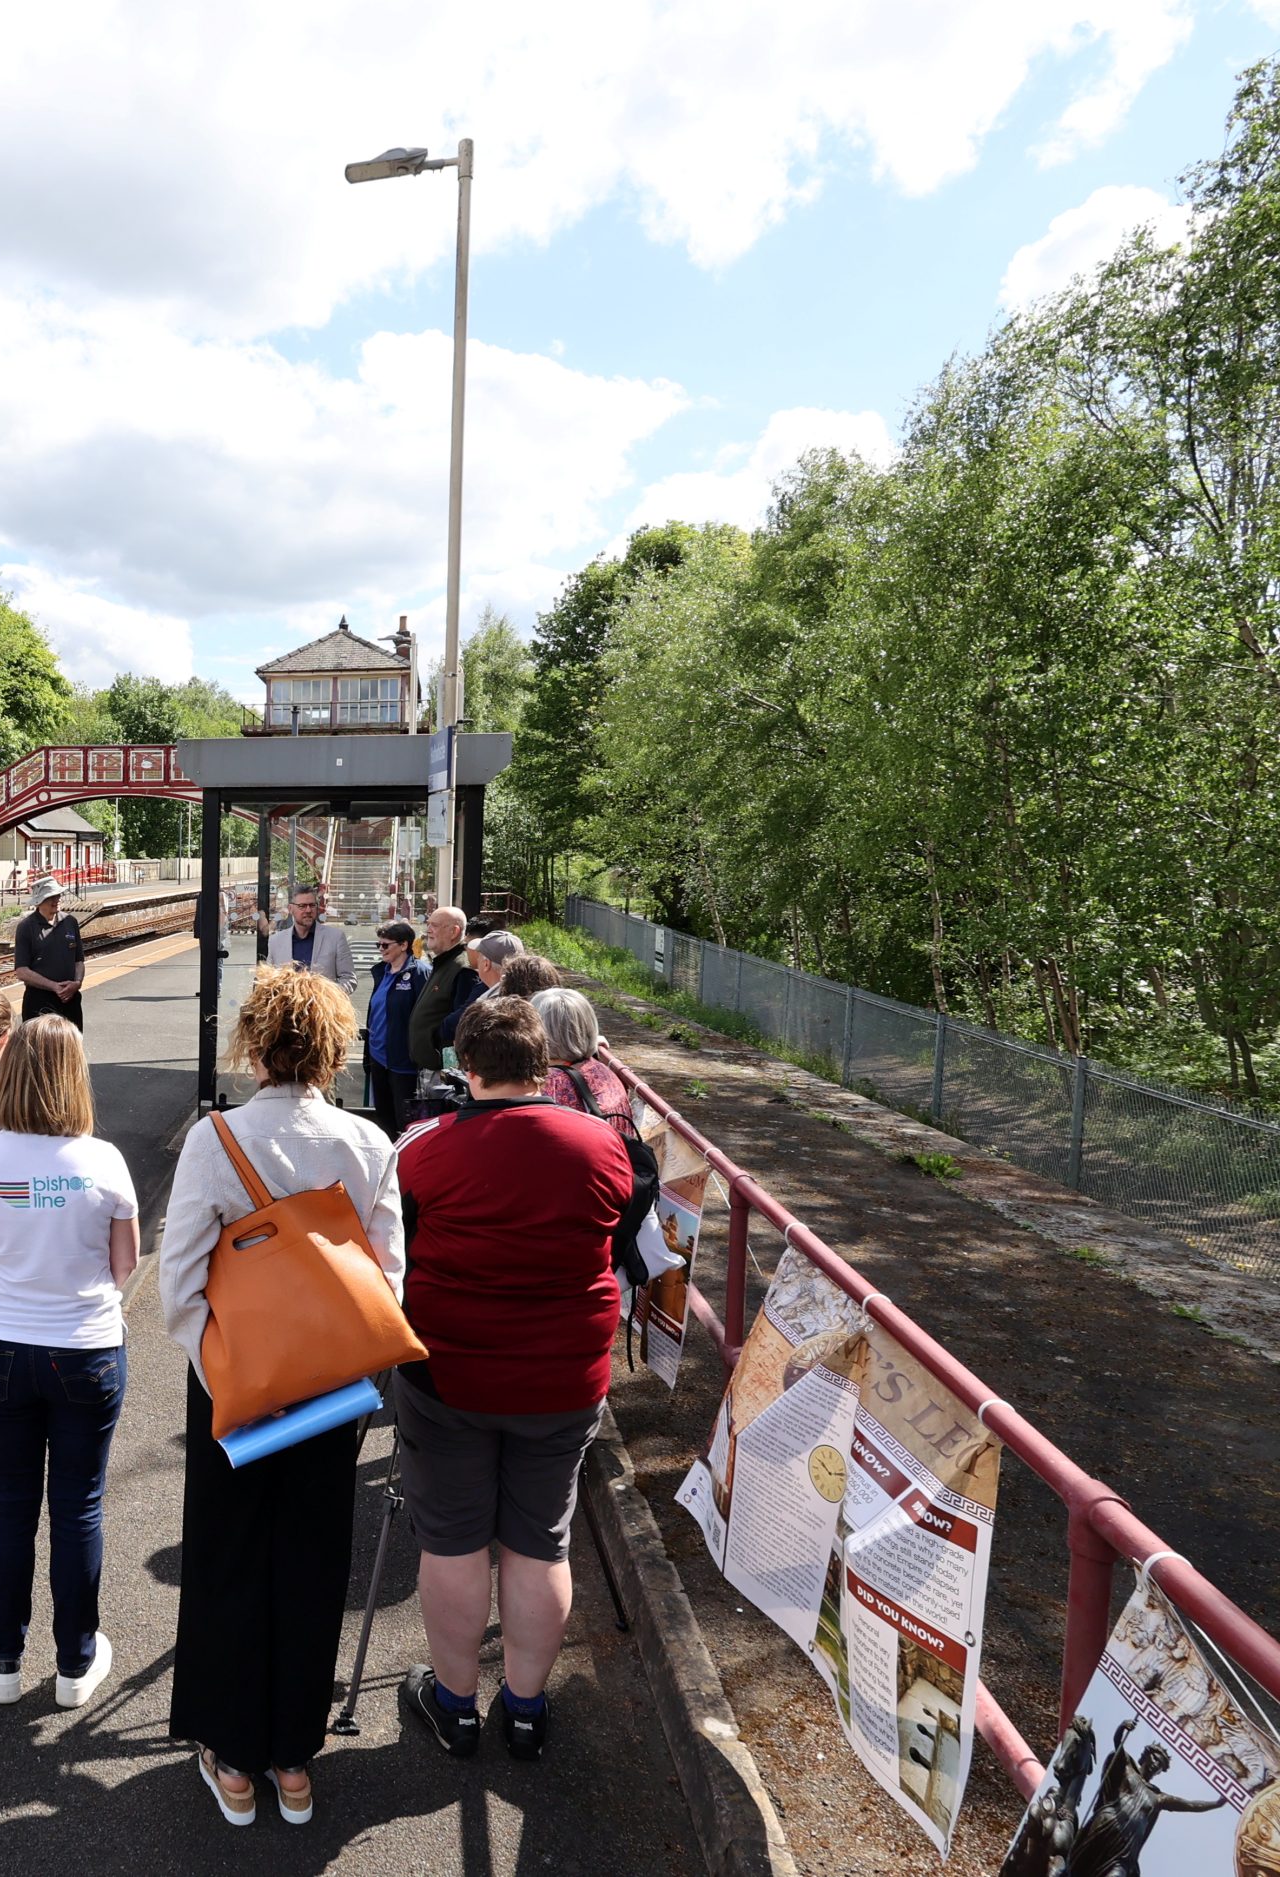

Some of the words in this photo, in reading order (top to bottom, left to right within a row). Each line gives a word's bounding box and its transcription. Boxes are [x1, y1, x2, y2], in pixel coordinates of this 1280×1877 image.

[32, 1176, 94, 1192] bishop
[33, 1192, 66, 1208] line
[853, 1440, 890, 1478] KNOW?
[848, 1478, 873, 1504] 250,000
[900, 1545, 912, 1558] still
[914, 1552, 934, 1570] stand
[935, 1565, 958, 1583] today.
[918, 1542, 934, 1559] why
[935, 1552, 944, 1563] so
[946, 1560, 968, 1578] many
[922, 1532, 964, 1562] high-grade
[874, 1551, 902, 1573] concrete
[902, 1568, 932, 1592] became
[932, 1586, 950, 1604] rare,
[950, 1598, 964, 1610] yet
[882, 1567, 901, 1584] most
[902, 1580, 960, 1620] commonly-used
[896, 1554, 922, 1575] Empire
[924, 1570, 960, 1596] collapsed
[856, 1584, 875, 1605] DID
[876, 1599, 899, 1622] YOU
[900, 1616, 944, 1652] KNOW?
[878, 1577, 904, 1598] material
[912, 1598, 924, 1611] the
[924, 1606, 948, 1624] world!
